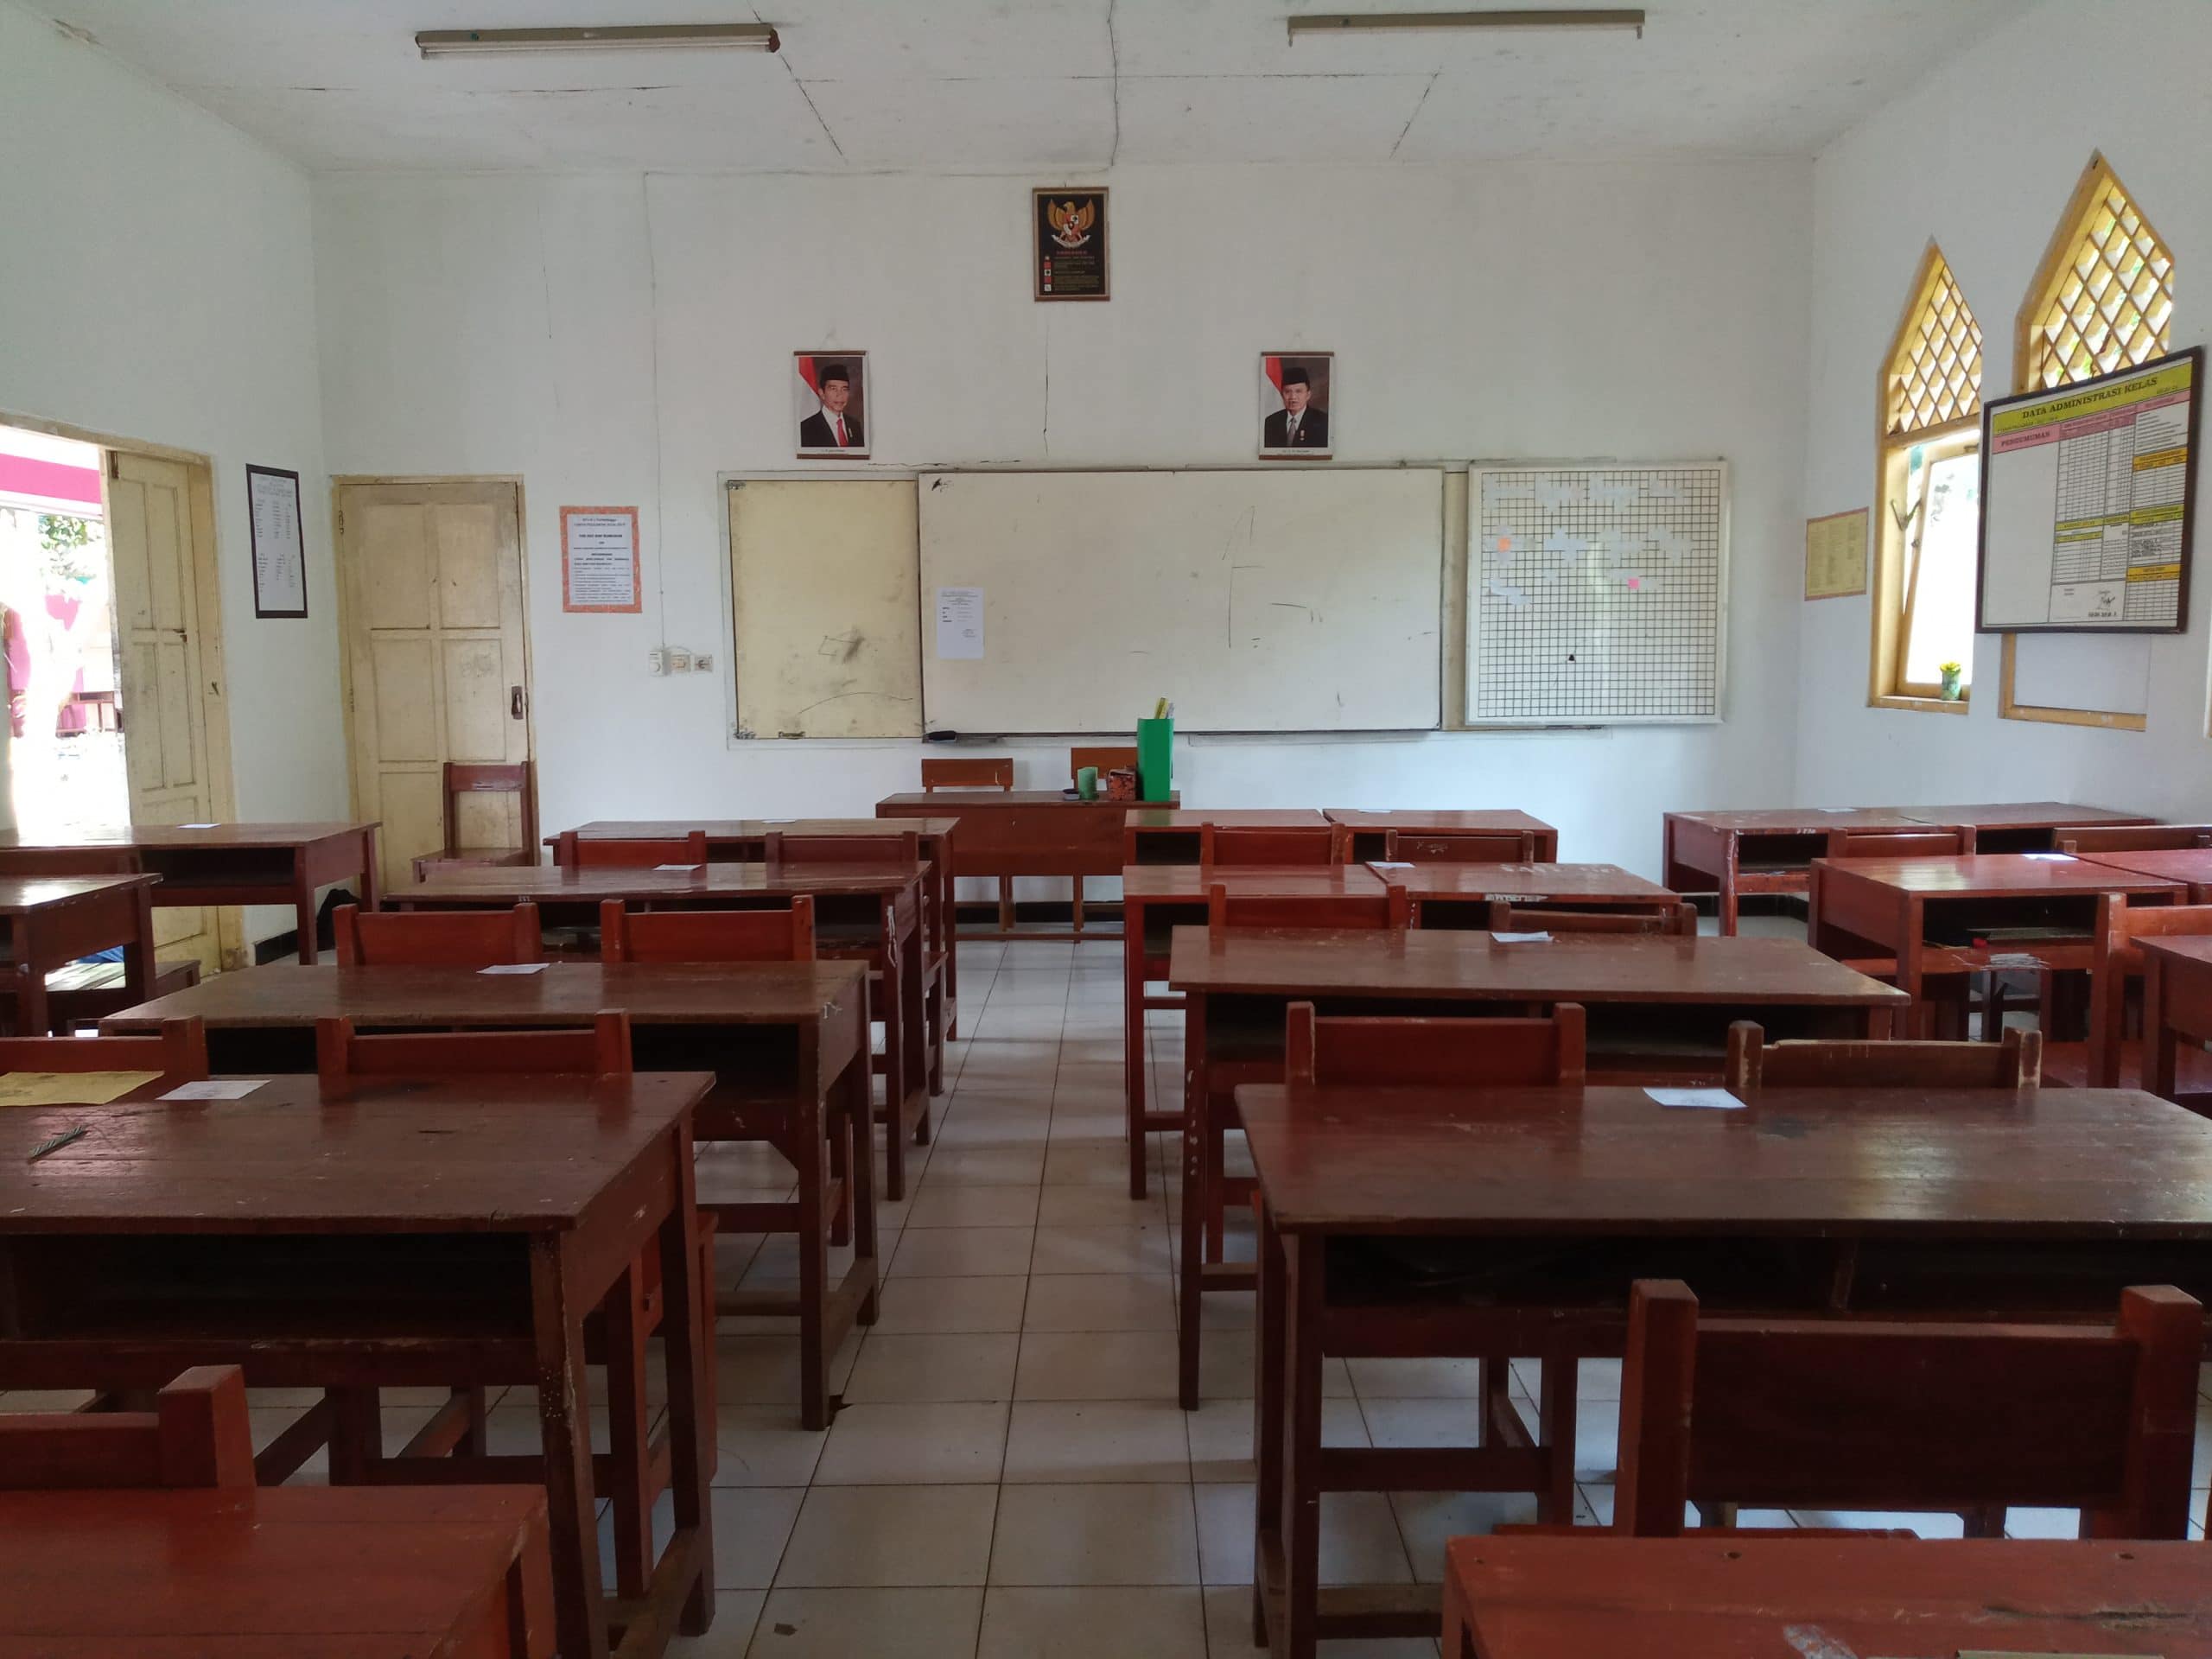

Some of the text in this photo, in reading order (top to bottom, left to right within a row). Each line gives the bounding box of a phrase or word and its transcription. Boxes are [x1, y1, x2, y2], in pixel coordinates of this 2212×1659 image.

[2022, 407, 2047, 419] DATA
[2050, 387, 2122, 413] ADMINISTRASI
[2124, 377, 2158, 394] KELAS
